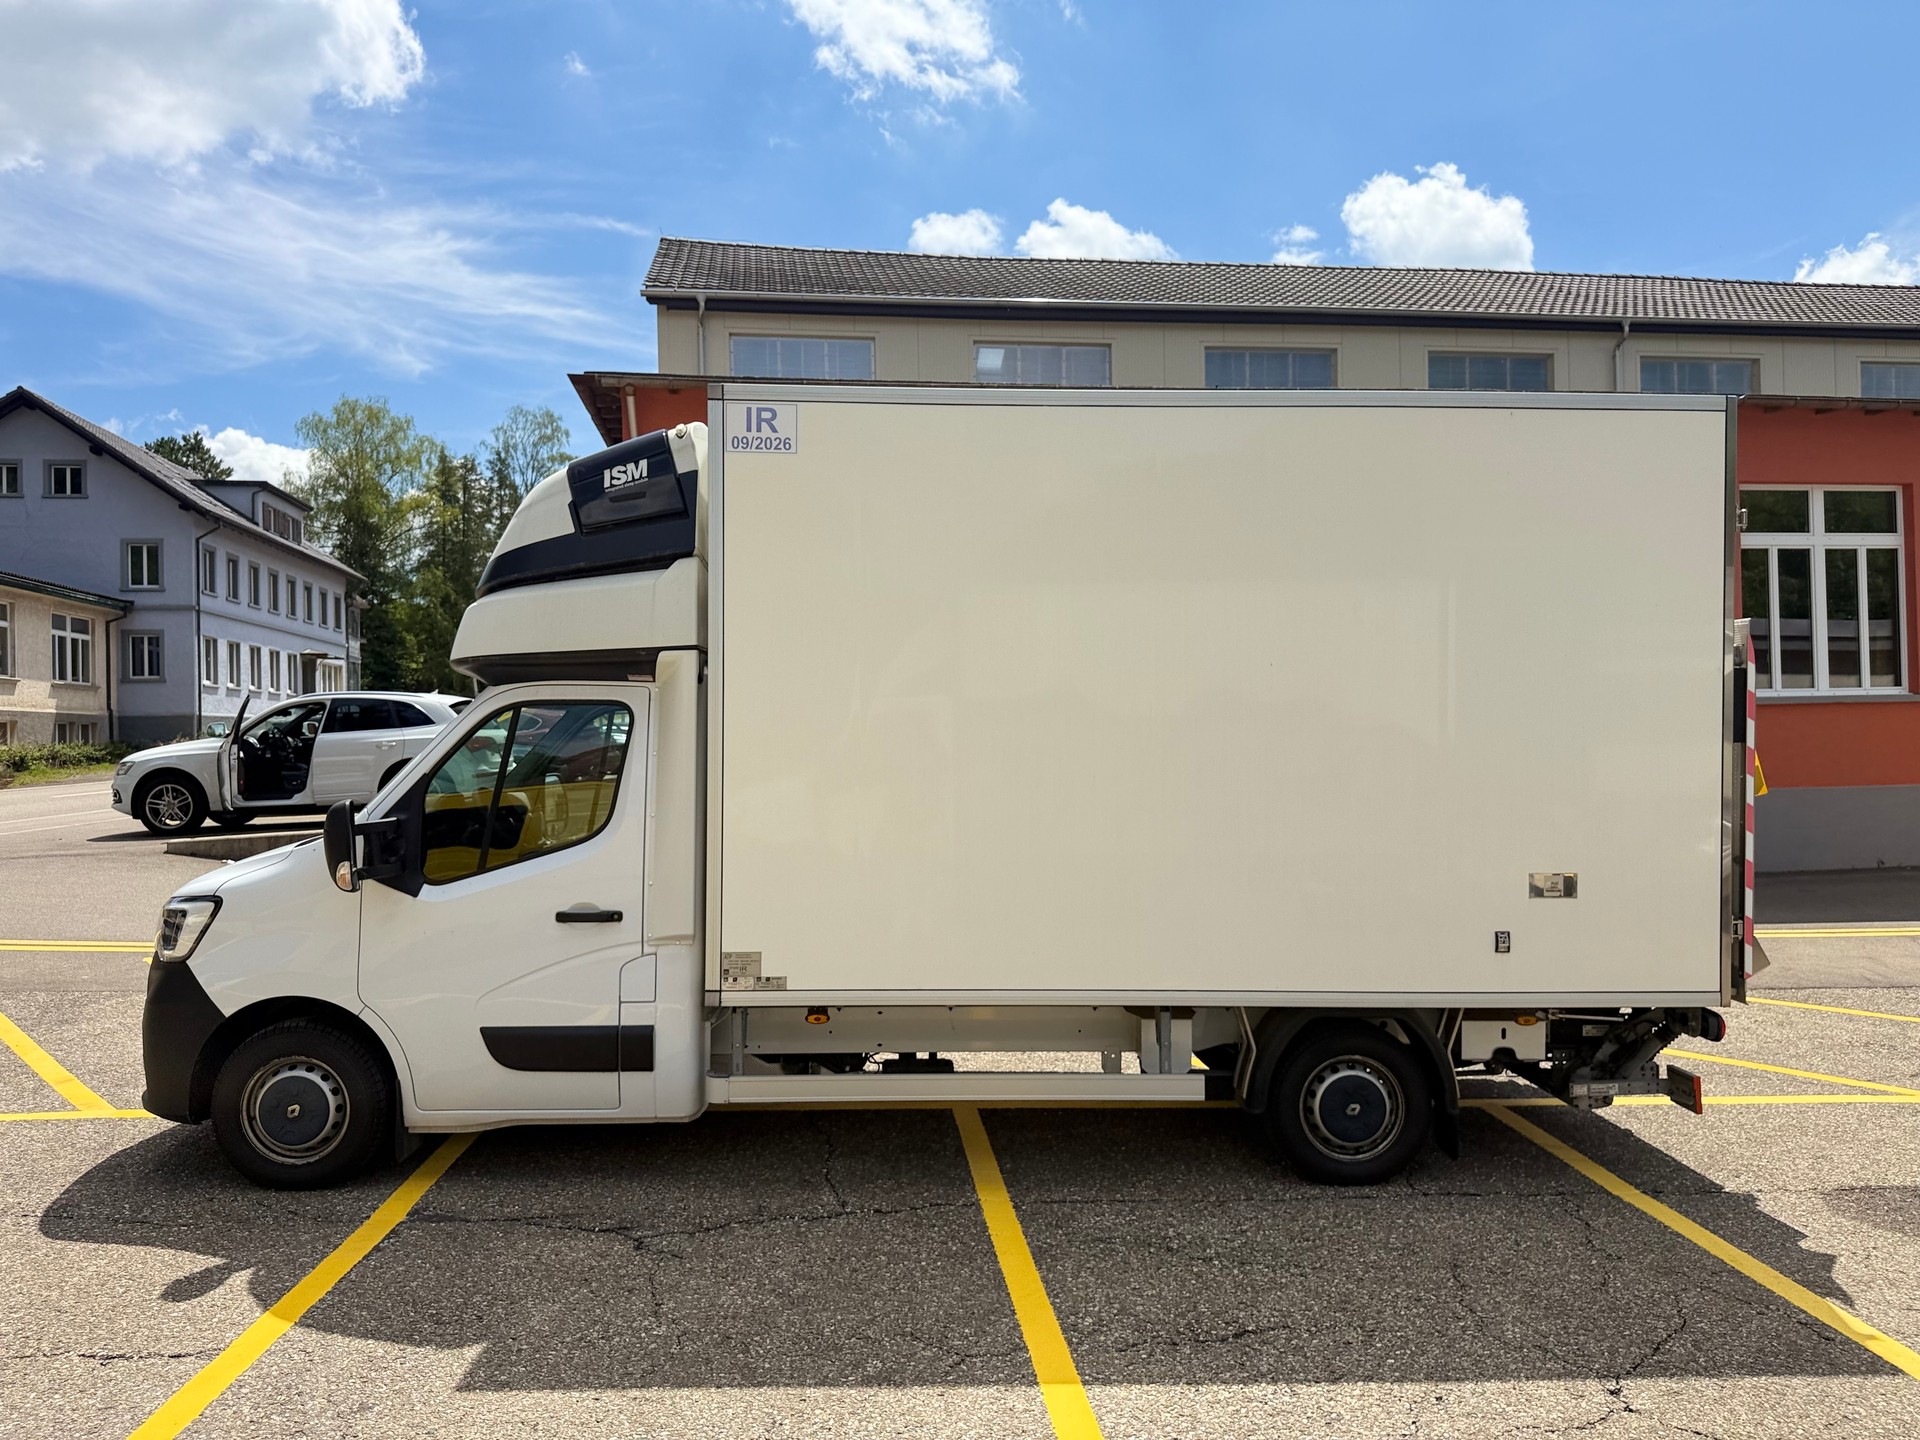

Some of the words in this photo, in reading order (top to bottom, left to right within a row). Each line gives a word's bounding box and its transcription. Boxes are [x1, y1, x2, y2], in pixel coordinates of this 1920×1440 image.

[746, 407, 779, 433] IR
[731, 436, 792, 451] 09/2026
[603, 458, 648, 488] ISM
